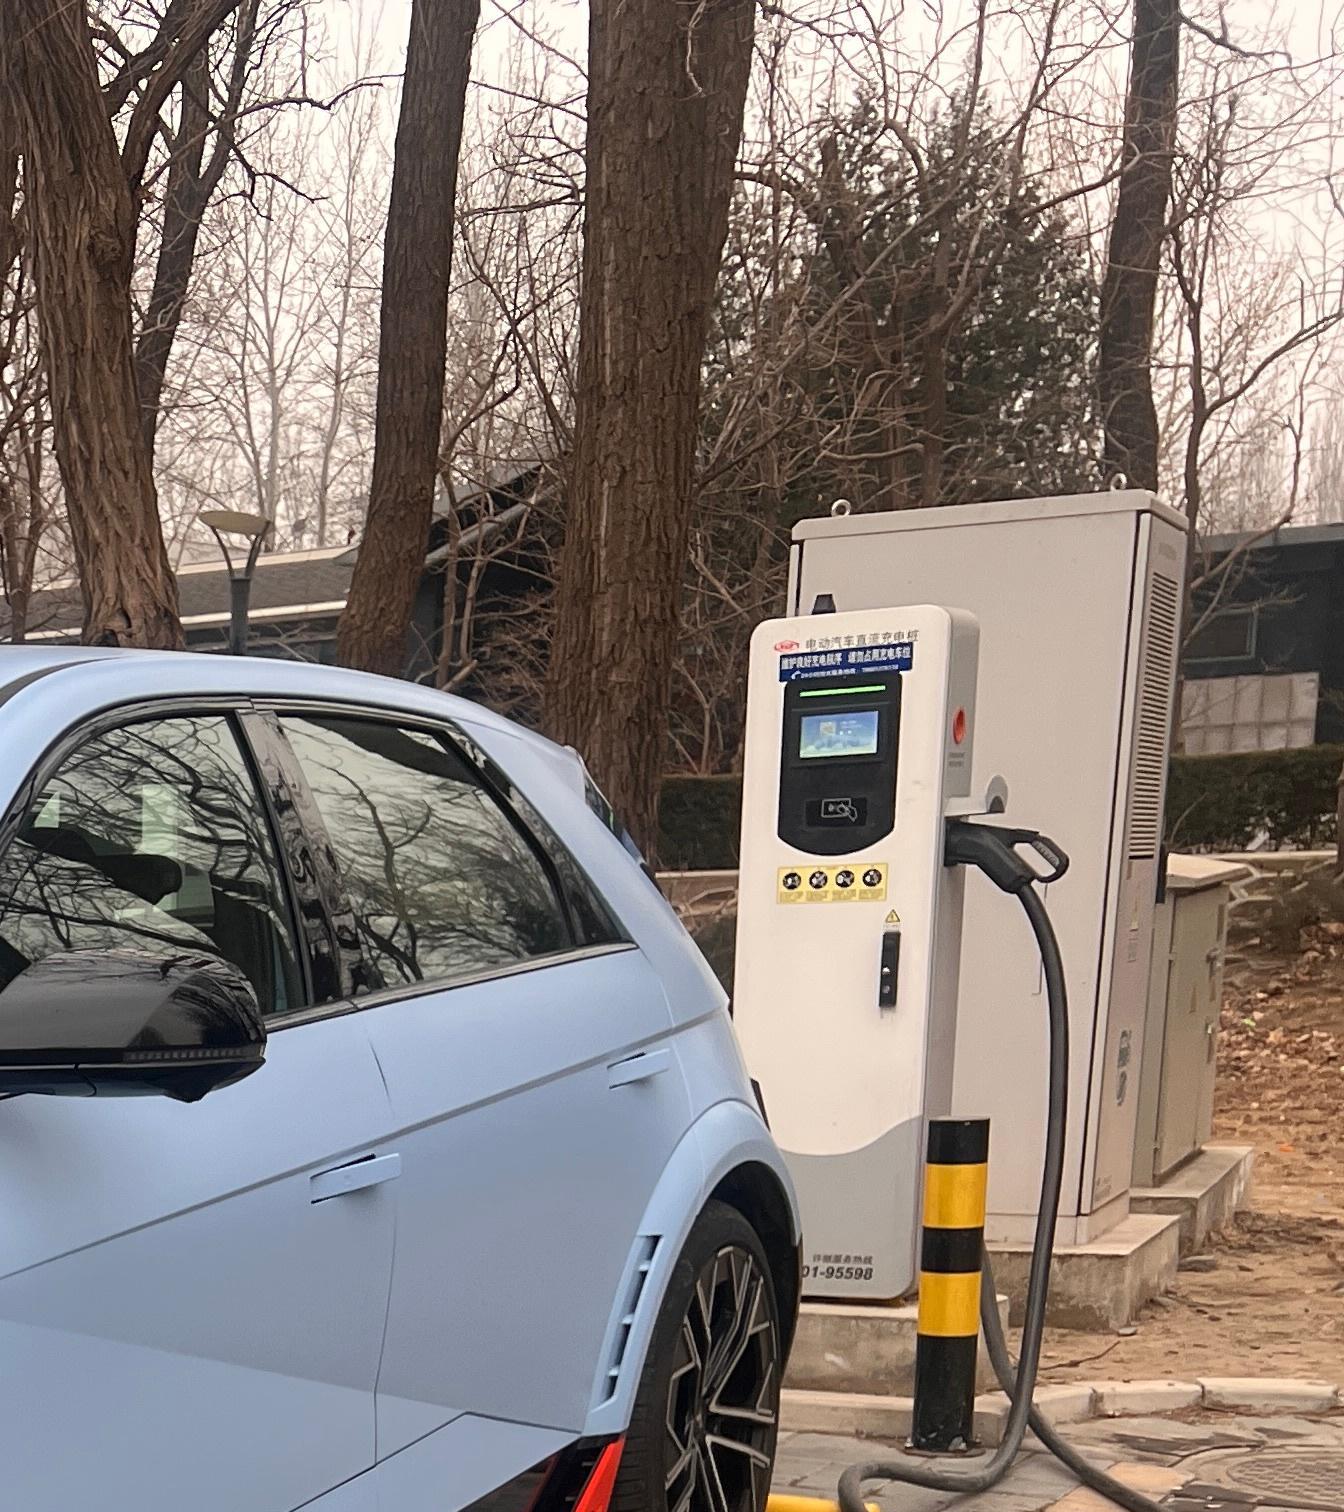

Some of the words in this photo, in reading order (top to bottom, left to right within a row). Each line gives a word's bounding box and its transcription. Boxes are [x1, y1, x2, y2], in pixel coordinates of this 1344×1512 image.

[806, 630, 919, 650] 电动汽车直流充电桩
